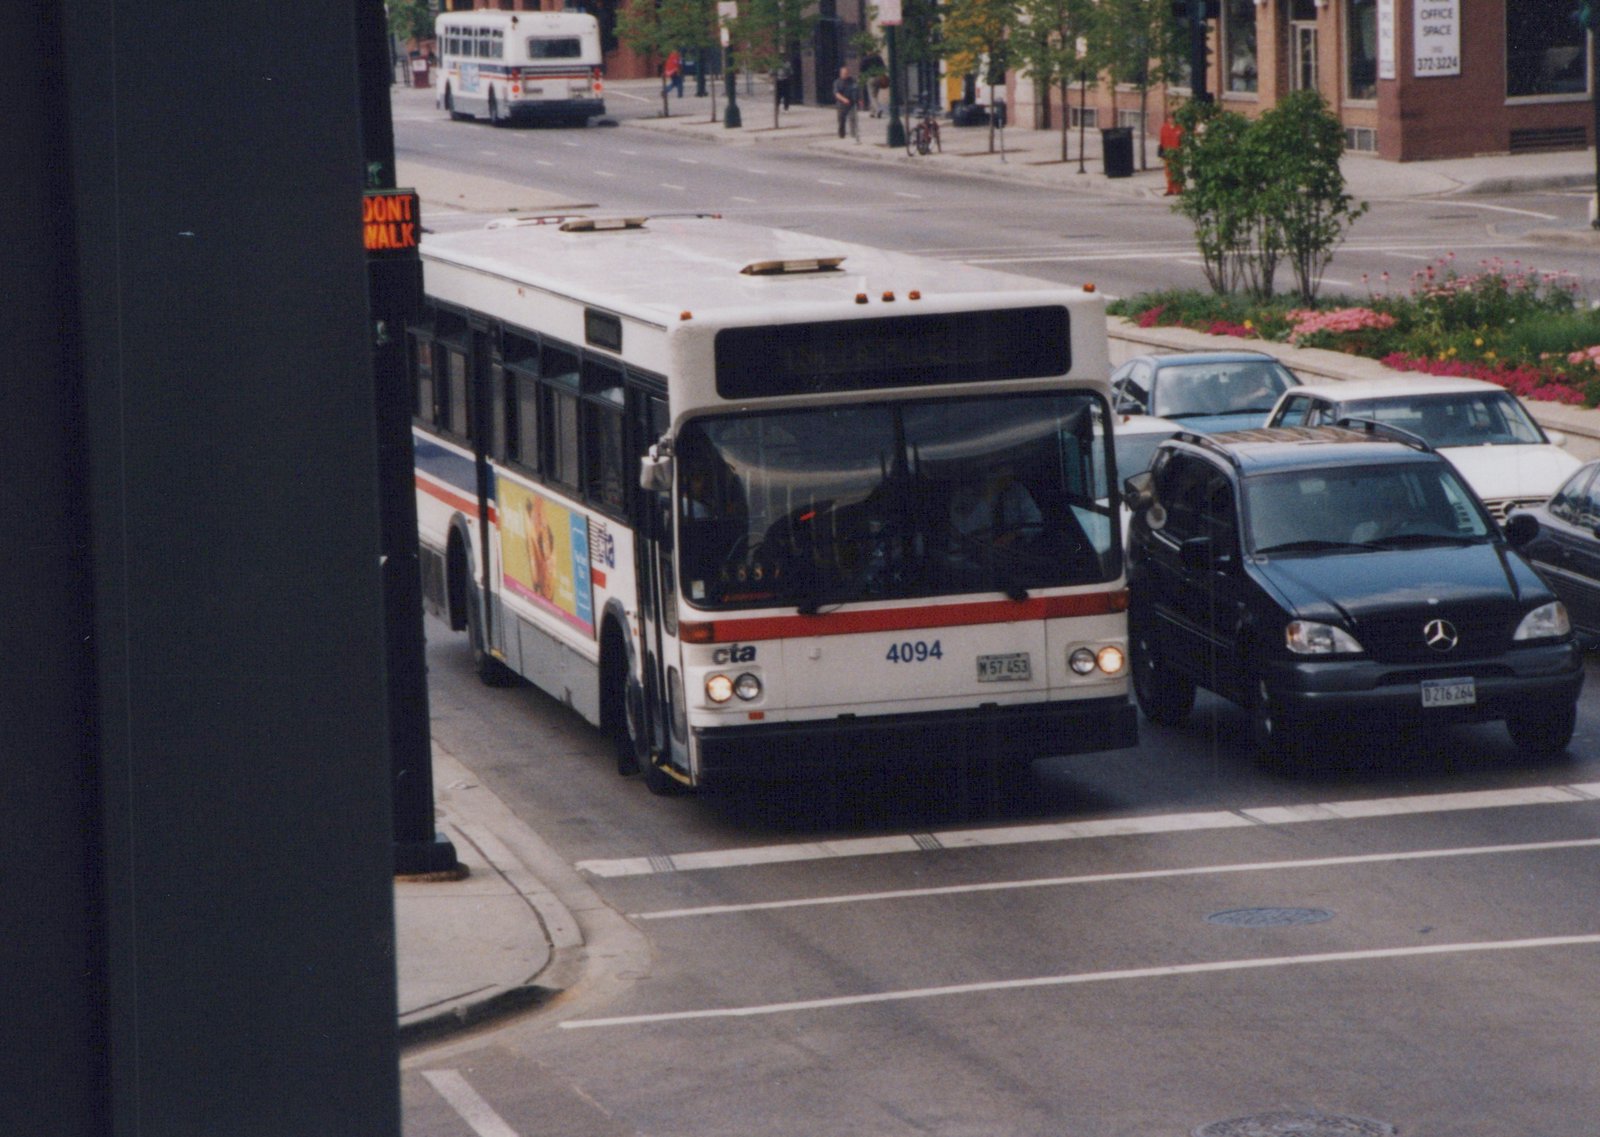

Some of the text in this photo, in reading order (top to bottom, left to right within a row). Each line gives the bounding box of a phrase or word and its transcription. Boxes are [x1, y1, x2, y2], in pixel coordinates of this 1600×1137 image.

[1421, 8, 1453, 20] OFFICE
[1423, 25, 1452, 37] SPACE
[1417, 56, 1458, 71] 372-3224
[712, 643, 756, 665] cta
[886, 640, 943, 663] 4094
